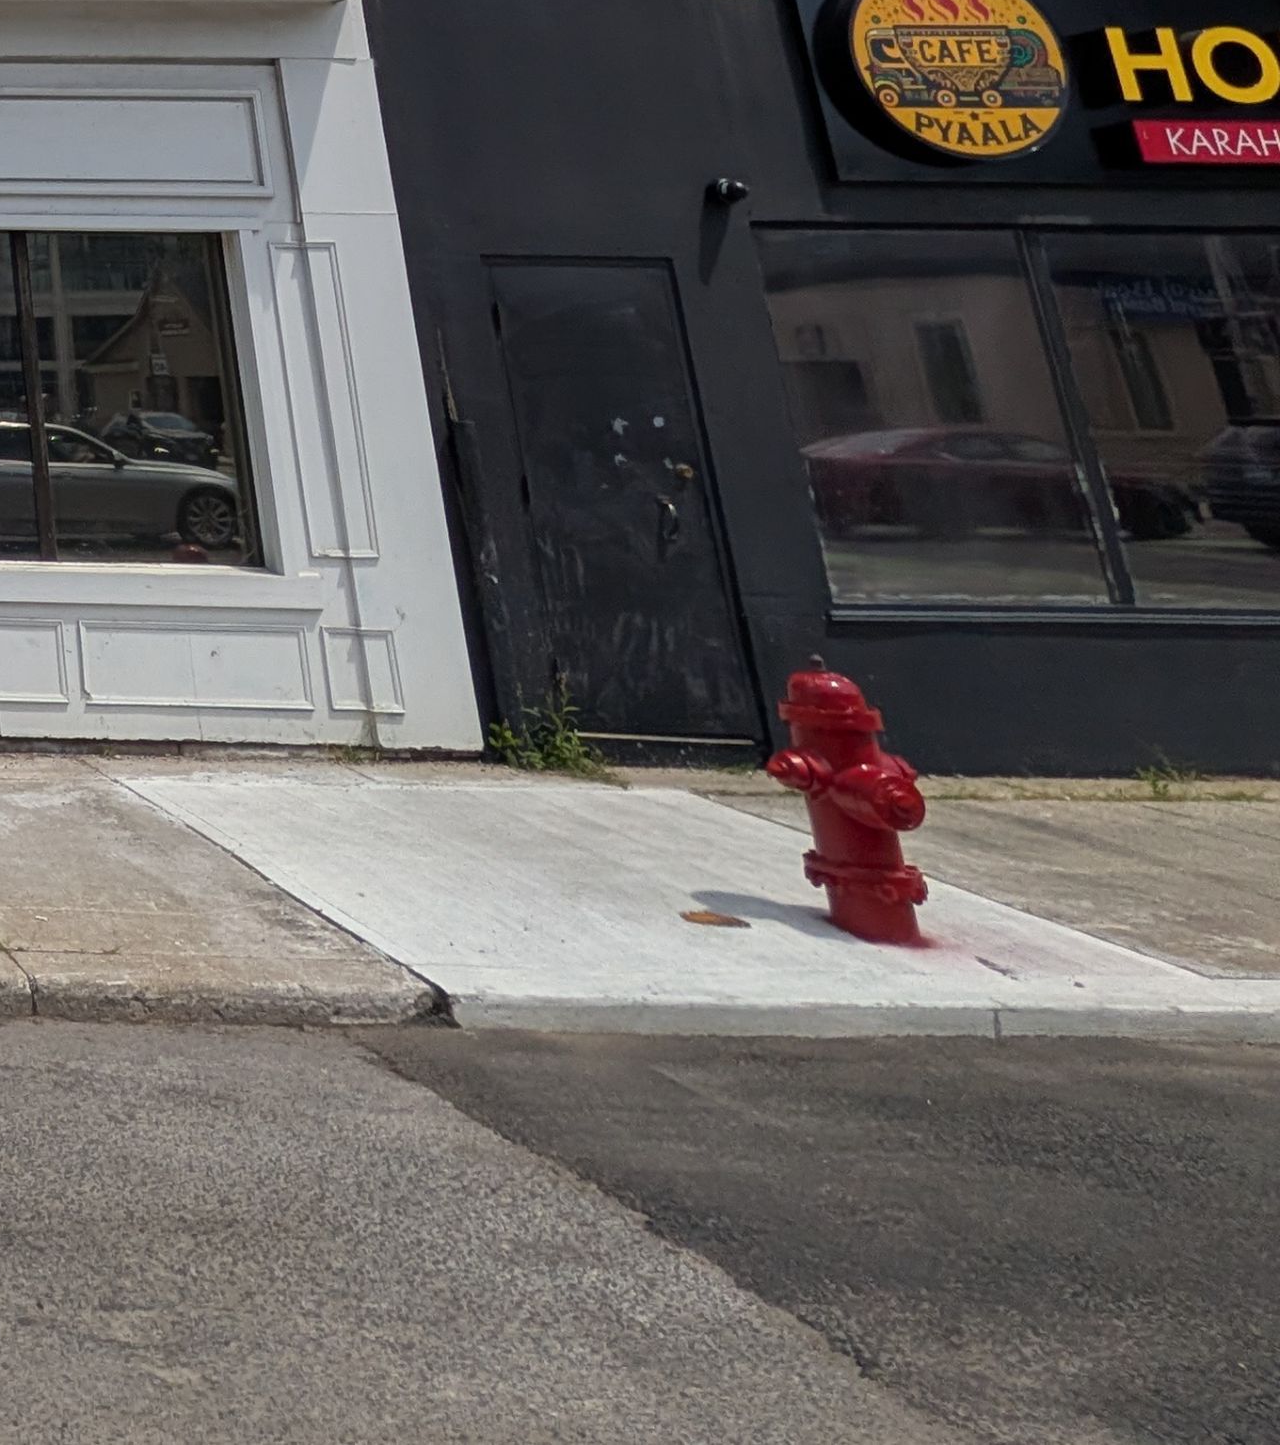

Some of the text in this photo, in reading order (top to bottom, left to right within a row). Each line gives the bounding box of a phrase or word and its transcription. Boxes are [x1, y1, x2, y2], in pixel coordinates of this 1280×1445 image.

[918, 38, 998, 65] CAFE
[1104, 26, 1280, 104] HO
[914, 111, 1044, 147] PYAALA
[1165, 126, 1280, 156] KARAH
